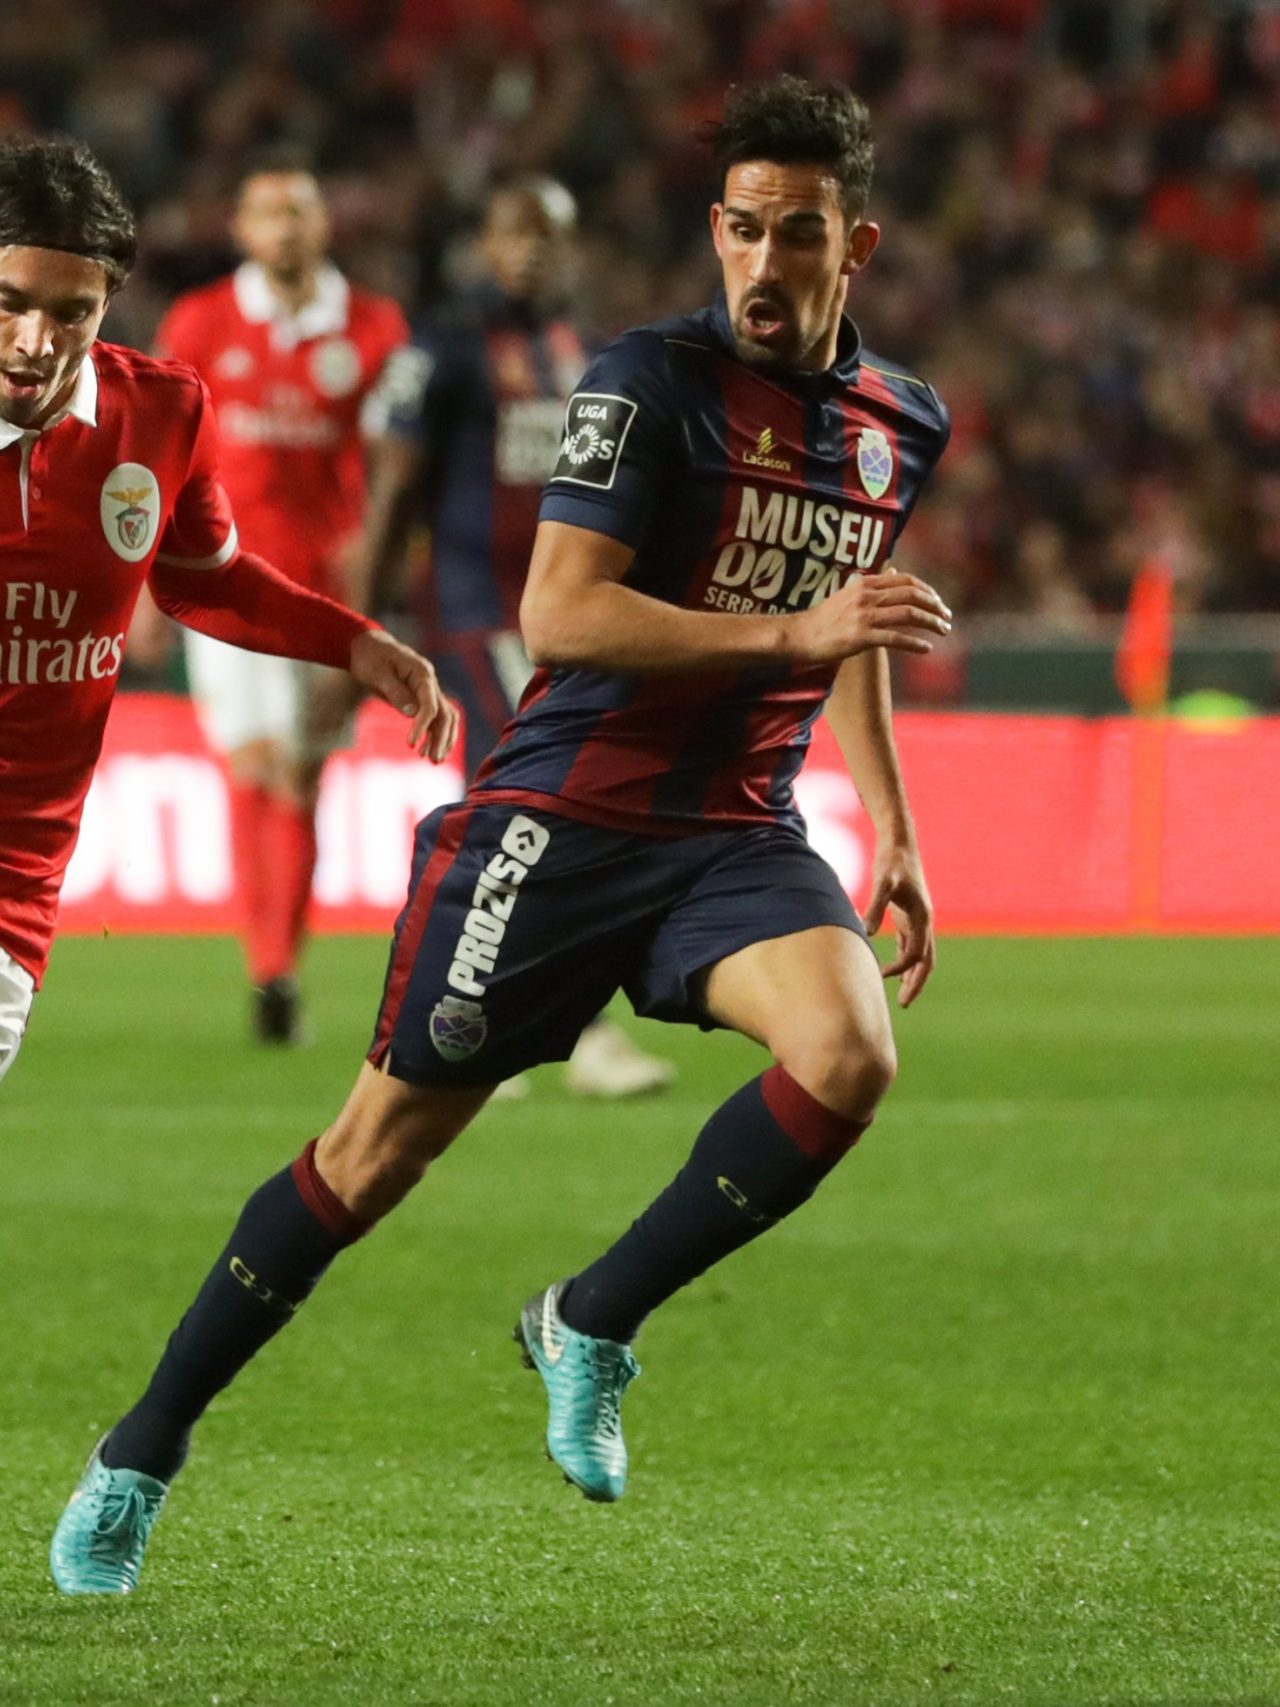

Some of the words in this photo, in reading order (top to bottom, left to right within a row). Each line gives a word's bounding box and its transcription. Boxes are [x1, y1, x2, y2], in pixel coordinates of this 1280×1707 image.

[577, 404, 608, 420] LIGA
[742, 451, 792, 472] Lacatoni
[735, 486, 884, 569] MUSEU
[711, 541, 787, 600] DO
[5, 582, 78, 629] Fly
[447, 852, 529, 997] PROZIS
